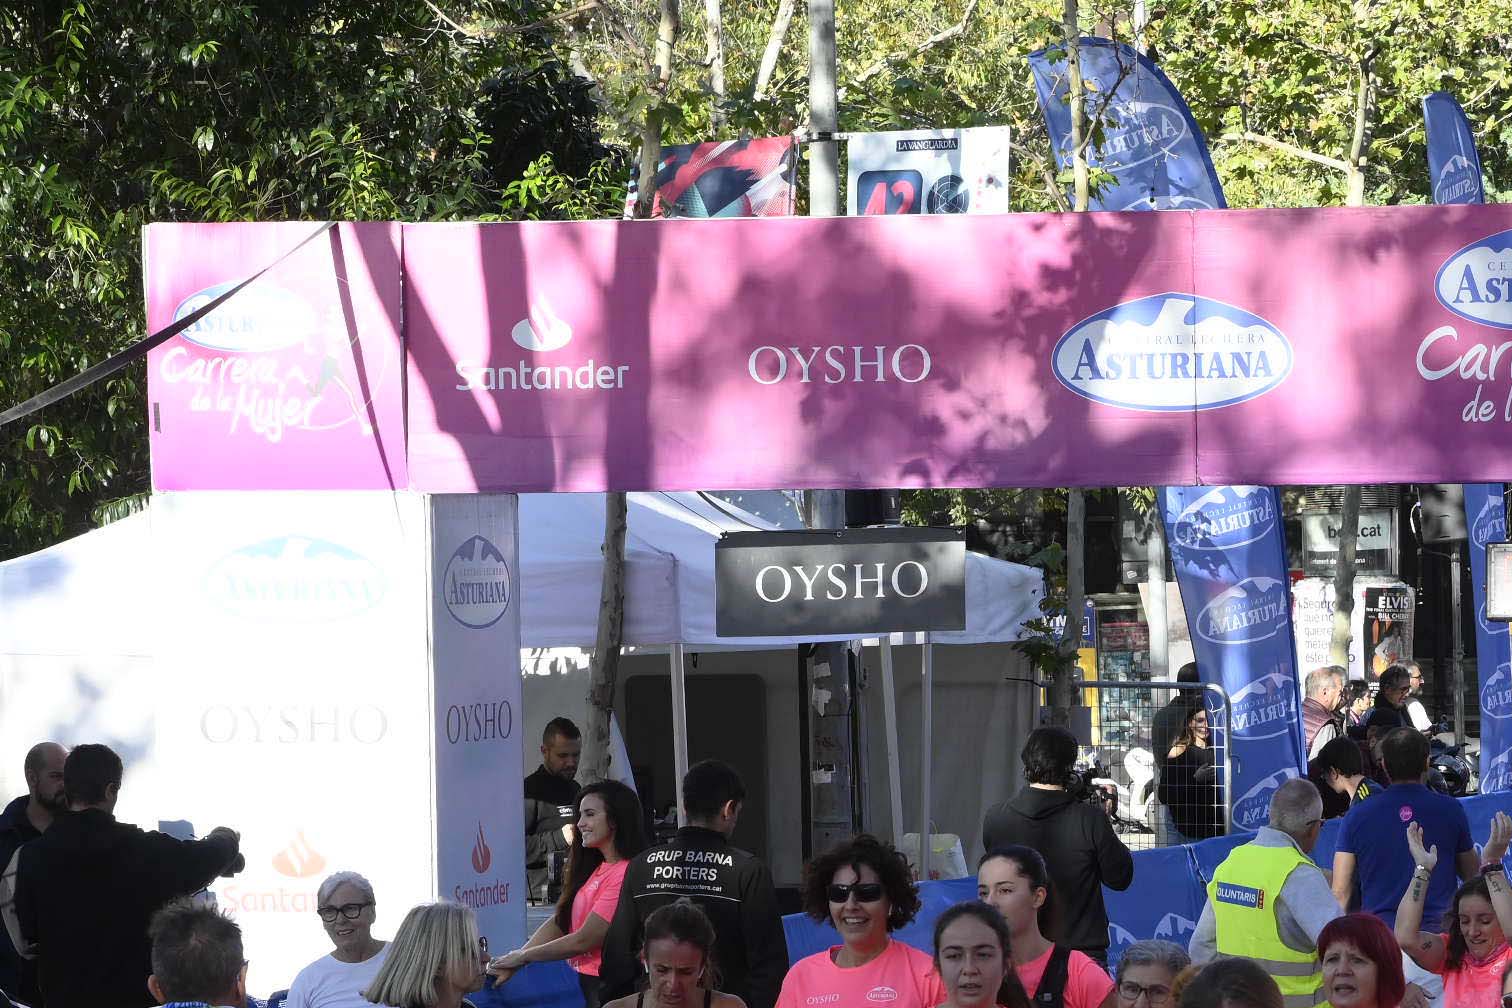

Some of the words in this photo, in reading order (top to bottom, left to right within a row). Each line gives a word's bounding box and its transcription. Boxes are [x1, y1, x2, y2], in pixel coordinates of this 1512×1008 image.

[159, 345, 282, 384] Carrera
[455, 358, 630, 391] Santander
[748, 343, 933, 385] OYSHO
[1070, 337, 1273, 381] ASTURIANA
[228, 377, 324, 444] Mujer
[1461, 383, 1497, 423] de
[449, 569, 507, 605] ASTURIANA
[755, 560, 929, 603] OYSHO
[1378, 595, 1410, 609] ELVIS
[200, 702, 389, 745] OYSHO
[446, 700, 513, 745] OYSHO
[646, 850, 683, 864] GRUP
[684, 850, 733, 867] BARNA
[653, 866, 718, 882] PORTERS
[222, 885, 319, 913] Santa
[454, 878, 510, 910] Santander
[1217, 887, 1256, 903] OLUNTARIS
[806, 993, 840, 1006] OYSHO
